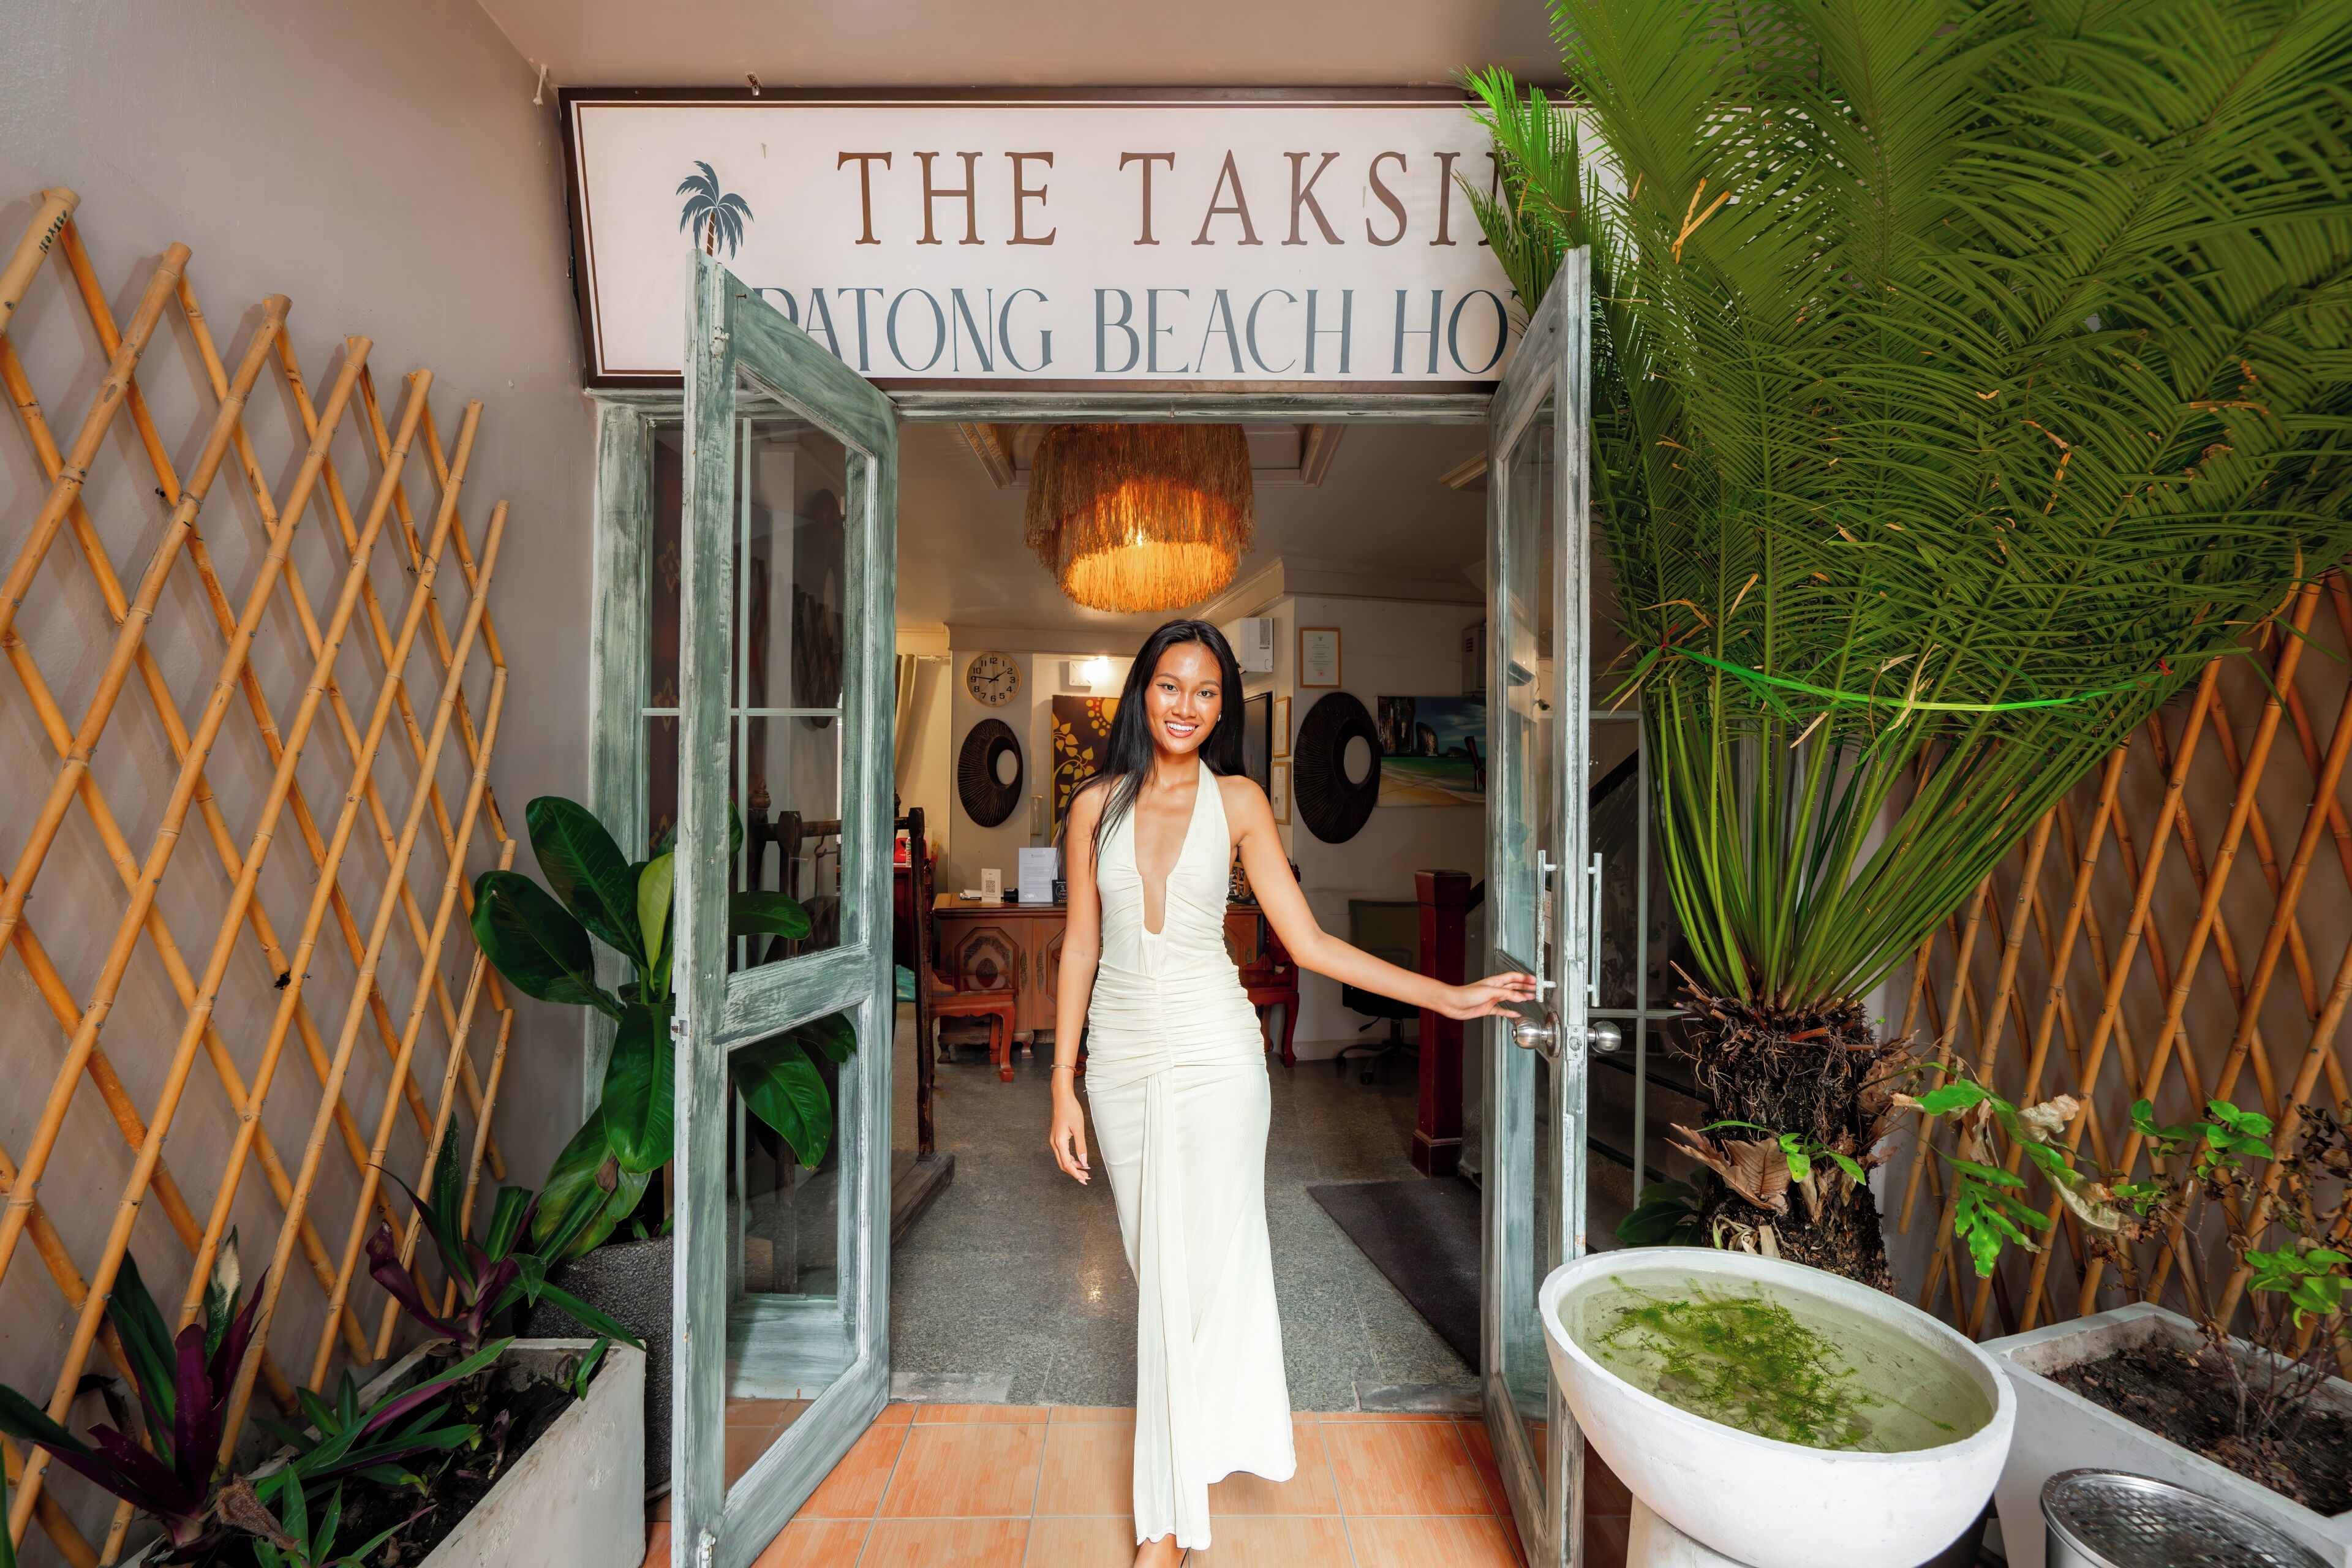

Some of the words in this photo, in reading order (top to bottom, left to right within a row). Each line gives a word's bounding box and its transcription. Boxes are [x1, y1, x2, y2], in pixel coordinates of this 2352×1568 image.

[837, 151, 1057, 246] THE
[1094, 288, 1354, 374] BEACH
[1391, 289, 1519, 374] HO
